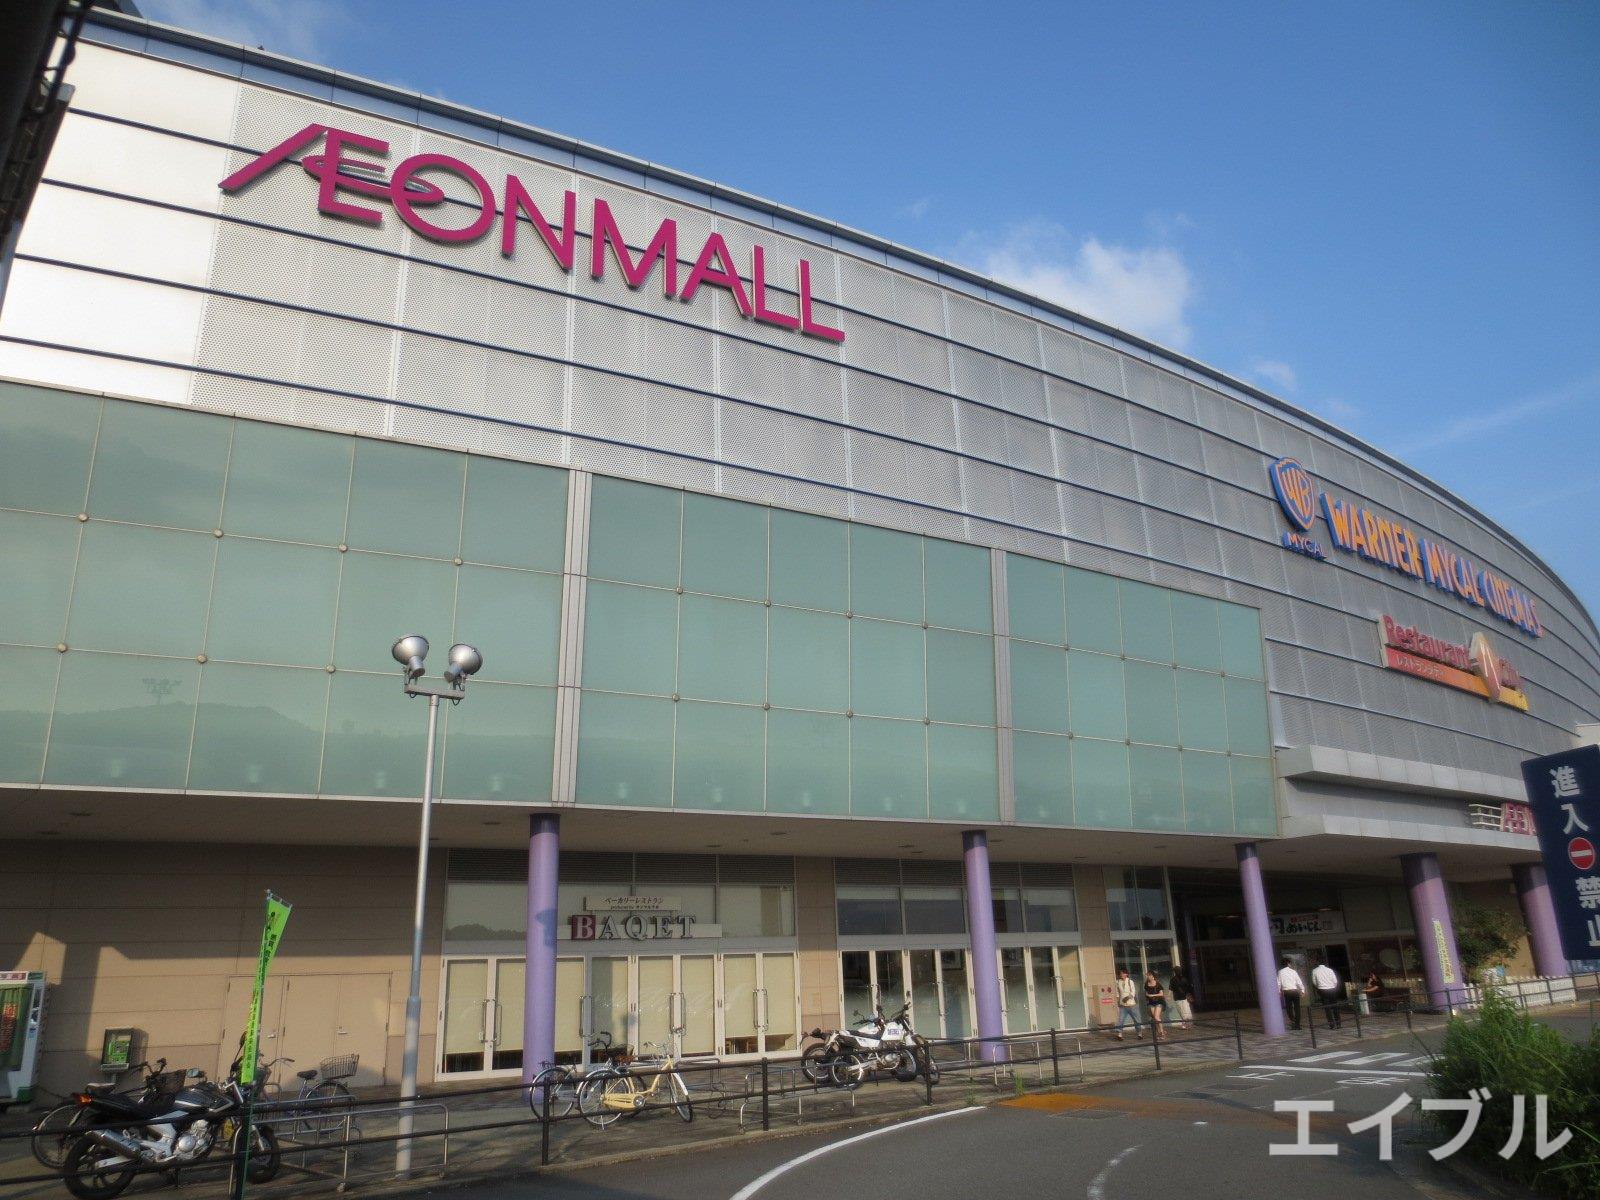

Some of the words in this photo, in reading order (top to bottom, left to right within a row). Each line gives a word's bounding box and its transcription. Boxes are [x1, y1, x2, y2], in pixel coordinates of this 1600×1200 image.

[1319, 492, 1424, 581] WARNER
[1420, 537, 1485, 608] MYCAL
[571, 914, 696, 941] BAQET
